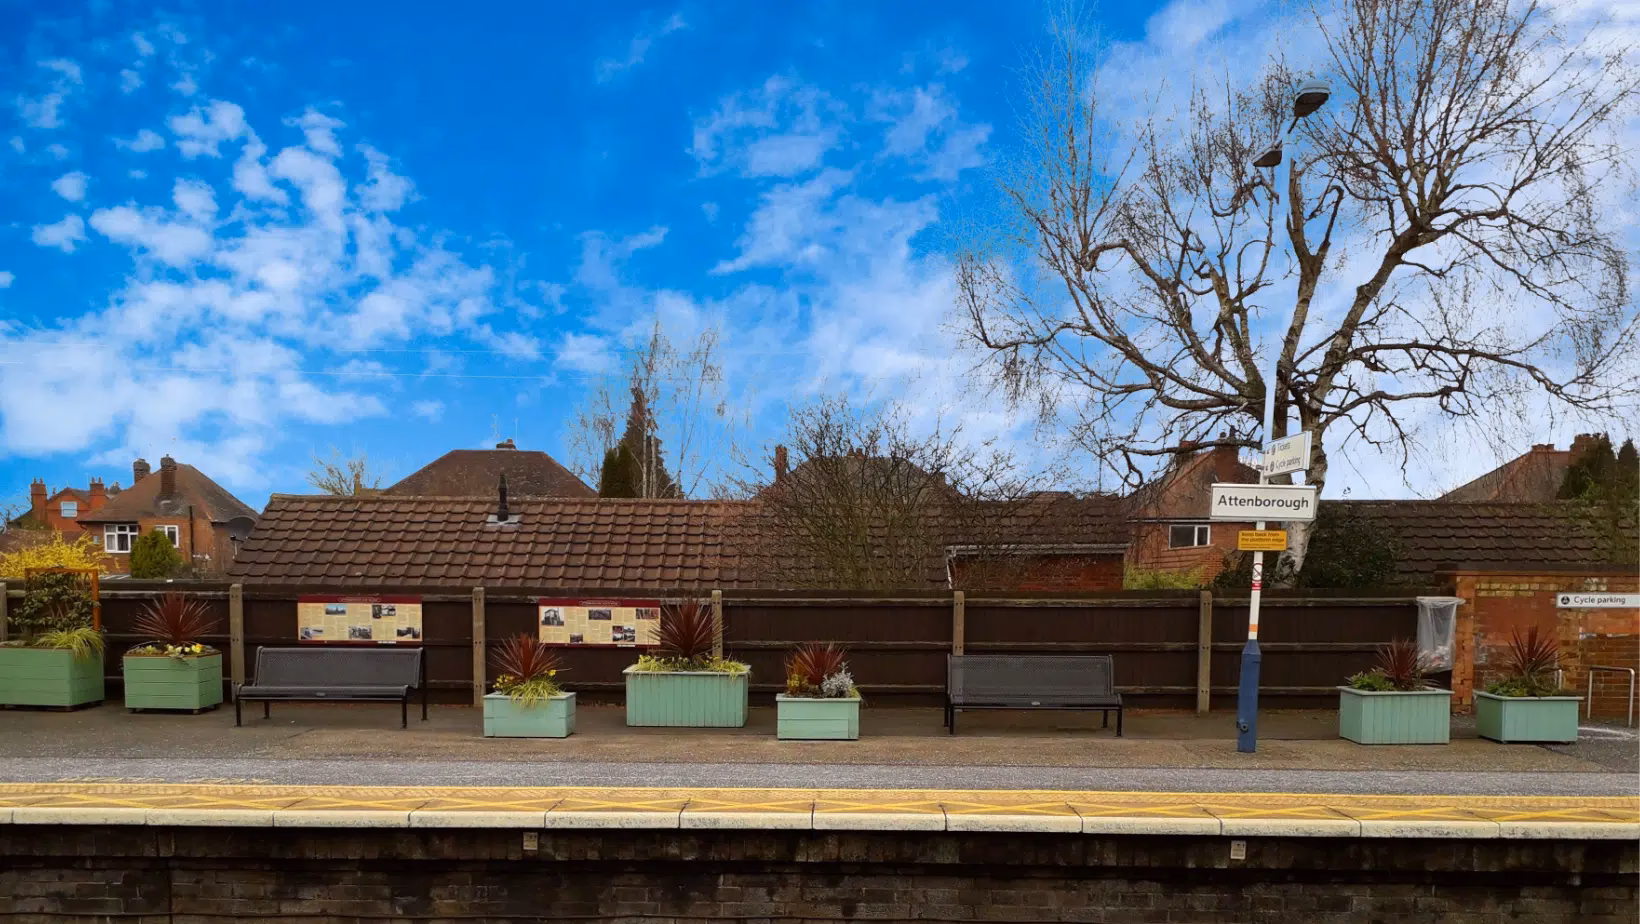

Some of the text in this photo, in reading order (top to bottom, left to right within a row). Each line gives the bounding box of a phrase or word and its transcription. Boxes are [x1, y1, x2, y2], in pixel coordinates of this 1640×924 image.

[1217, 495, 1309, 510] Attenborough
[1573, 596, 1626, 604] Cycle parking
